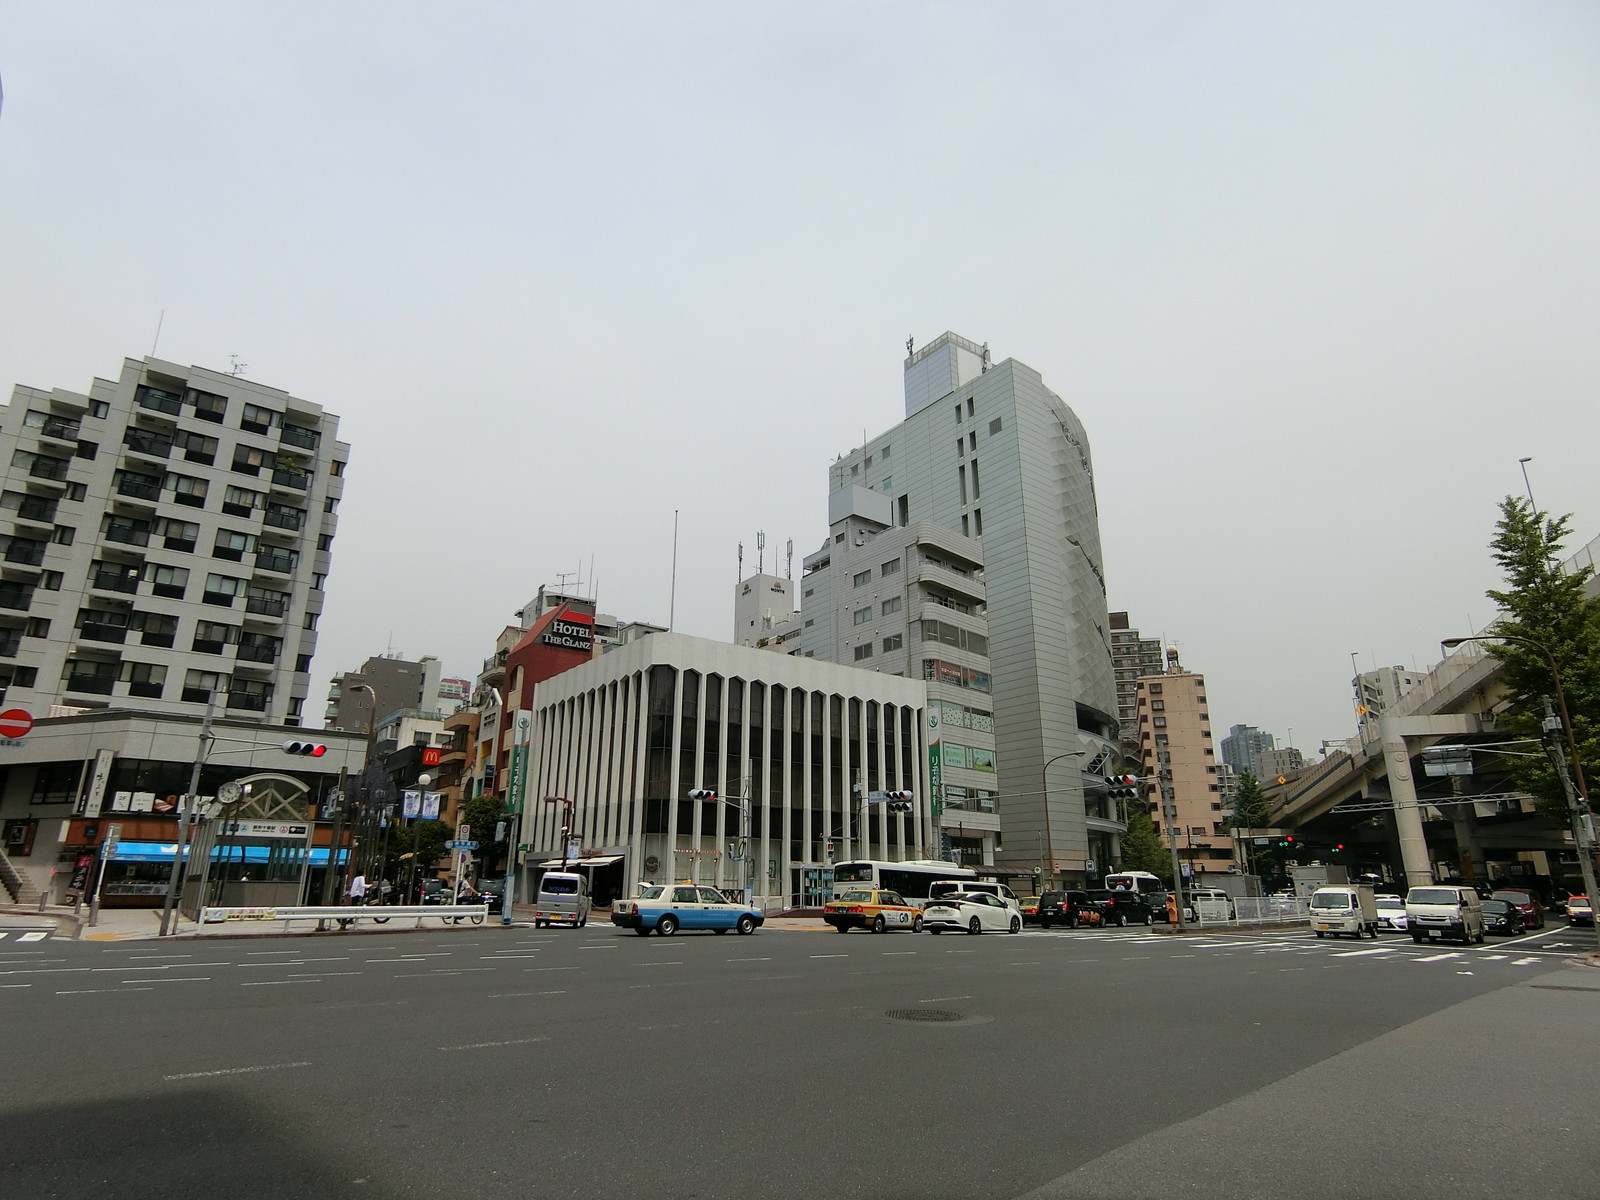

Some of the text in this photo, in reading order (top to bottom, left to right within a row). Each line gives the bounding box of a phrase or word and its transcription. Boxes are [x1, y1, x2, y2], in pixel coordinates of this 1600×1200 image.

[552, 621, 591, 638] HOTEL
[543, 633, 591, 650] THE GLANZ
